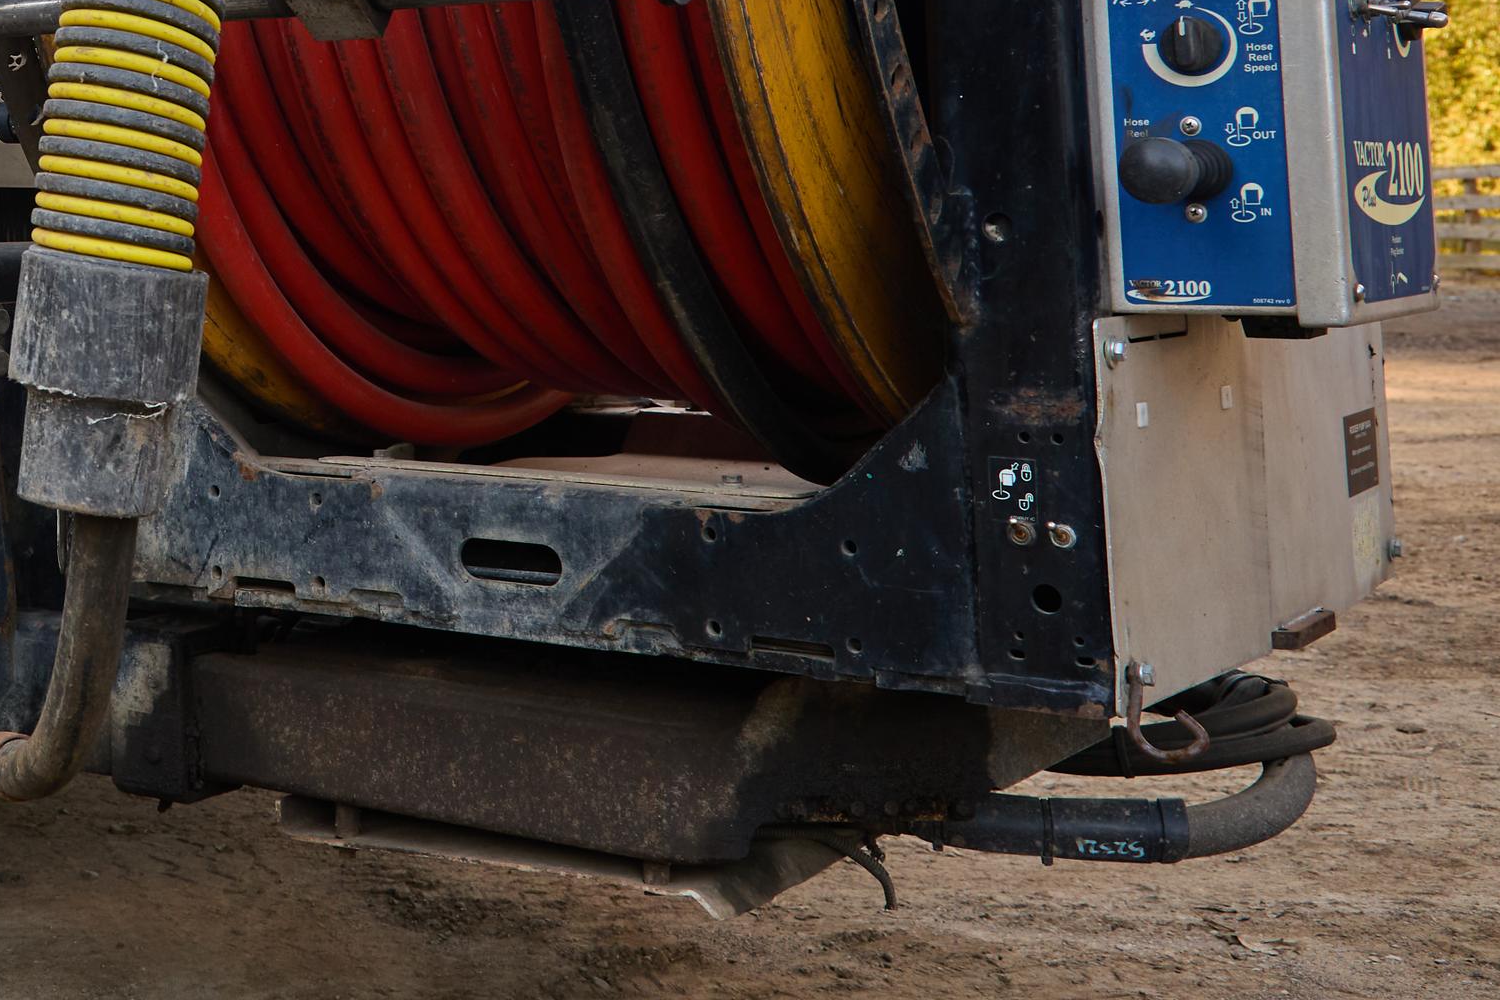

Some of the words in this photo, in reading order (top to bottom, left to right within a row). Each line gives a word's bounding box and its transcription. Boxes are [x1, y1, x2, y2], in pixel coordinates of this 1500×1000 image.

[1245, 42, 1274, 52] Hose
[1248, 52, 1273, 62] Reel
[1243, 62, 1278, 74] Speed
[1123, 118, 1150, 127] Hose
[1252, 130, 1277, 140] OUT
[1353, 140, 1386, 167] VACTOR
[1386, 140, 1424, 197] 2100
[1260, 207, 1273, 217] IN
[1163, 279, 1212, 296] 2100
